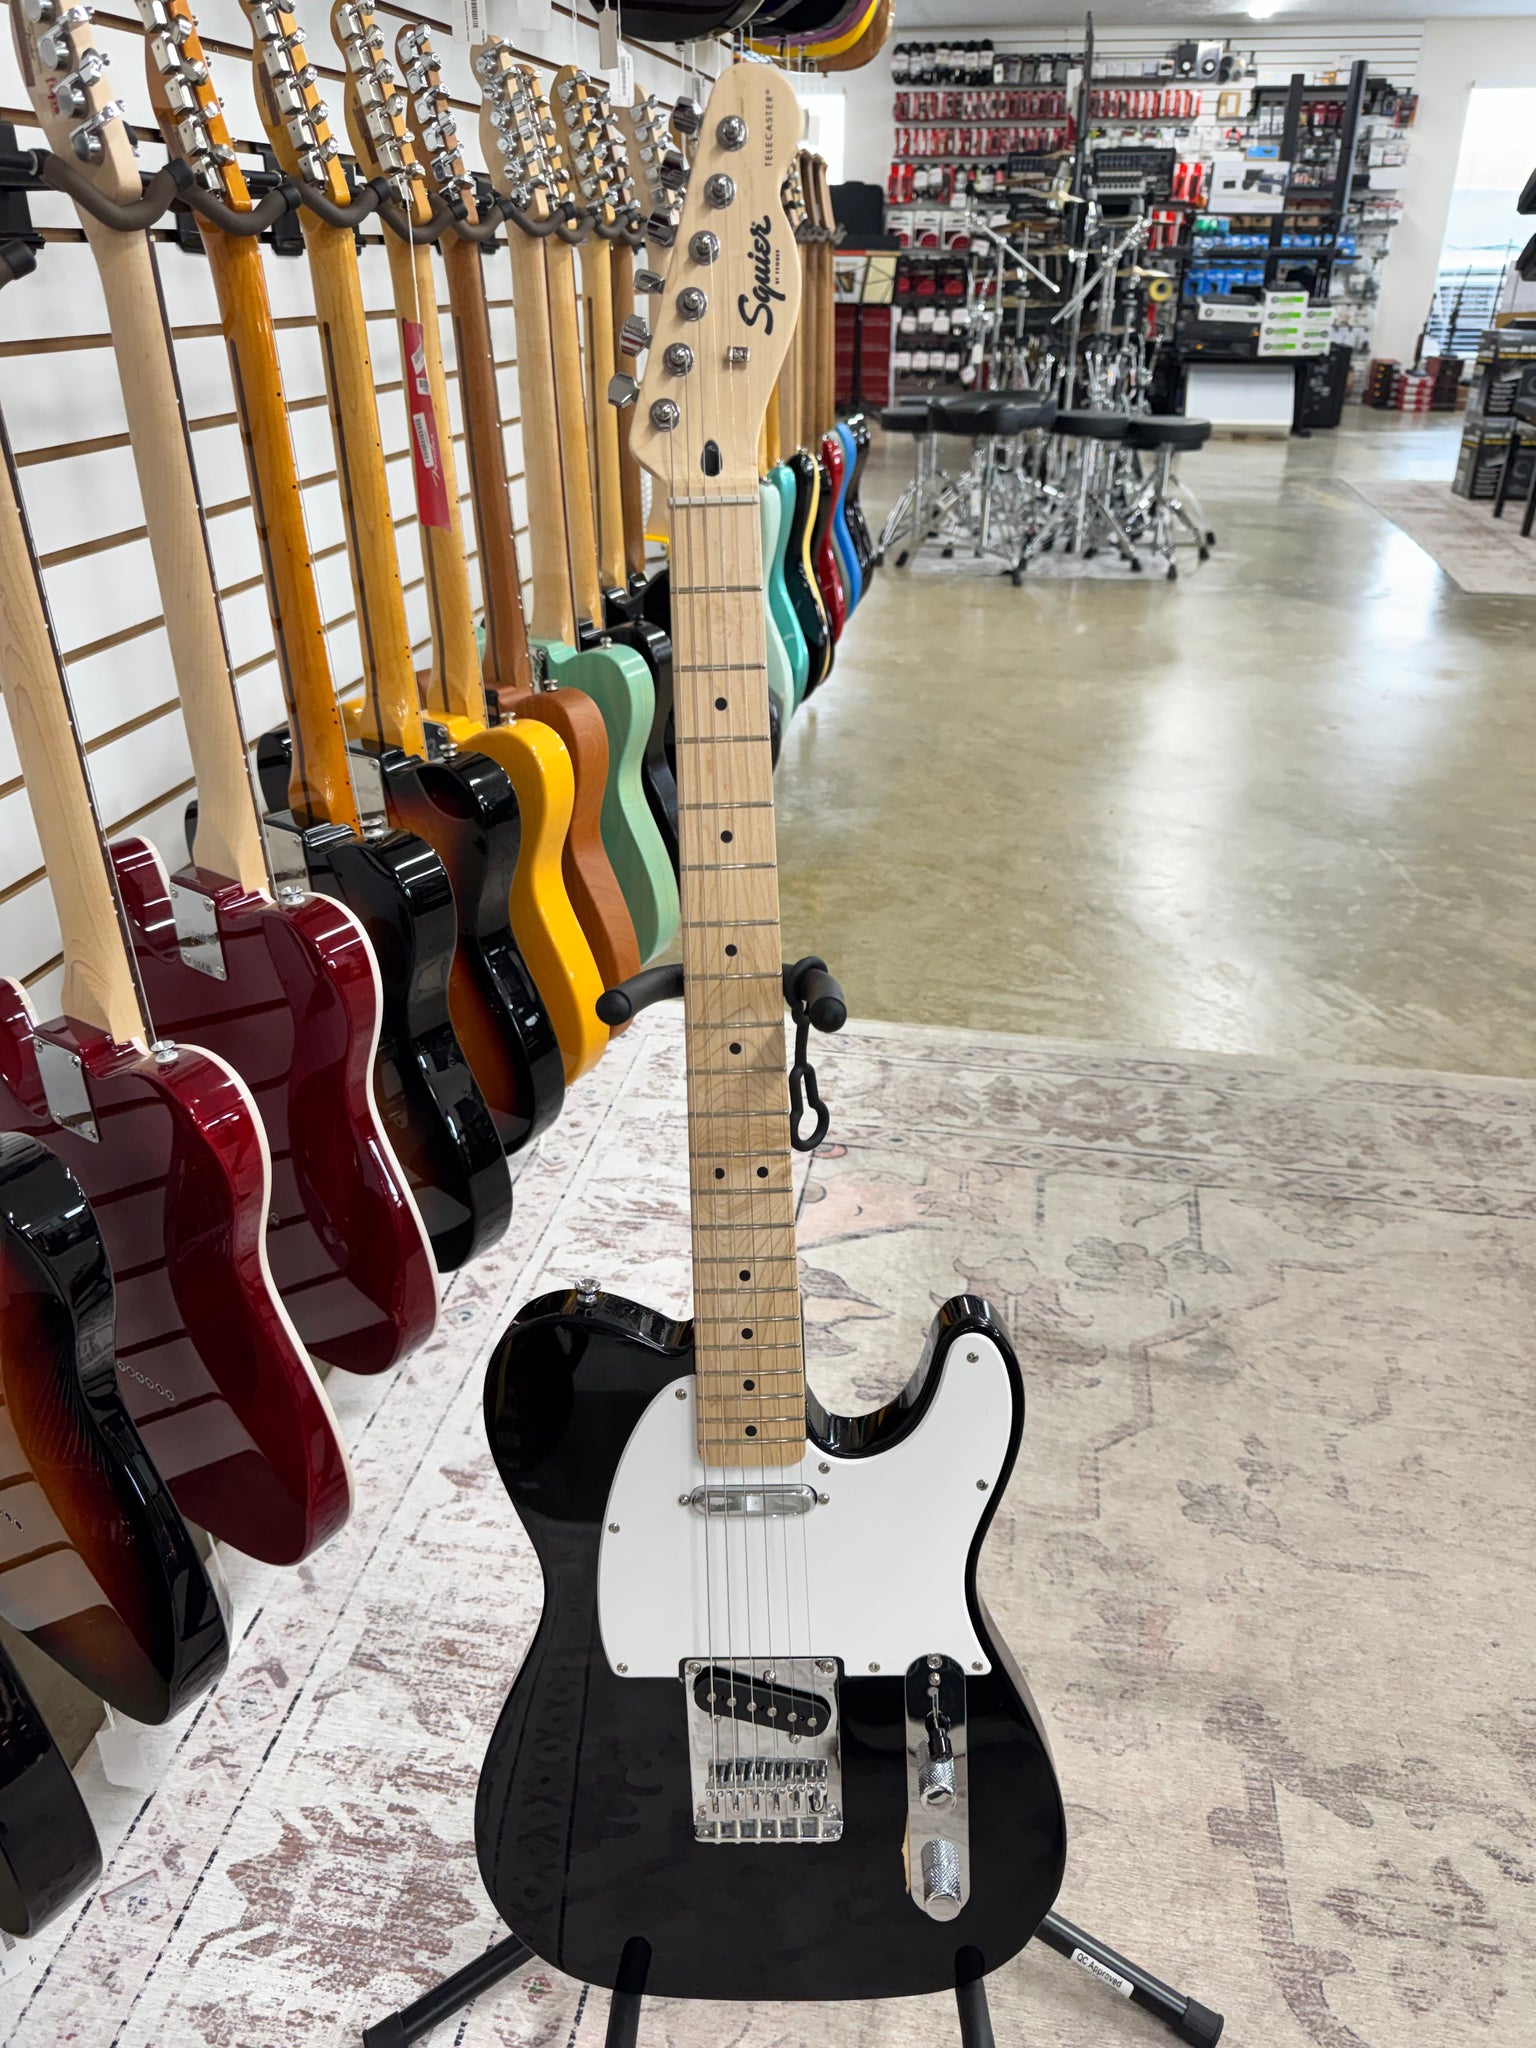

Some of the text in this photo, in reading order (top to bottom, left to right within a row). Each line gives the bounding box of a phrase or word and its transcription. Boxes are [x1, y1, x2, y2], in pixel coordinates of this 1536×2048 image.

[765, 96, 774, 168] TELECASTER
[738, 215, 786, 336] Squier
[1076, 1952, 1123, 1988] QC Approved
